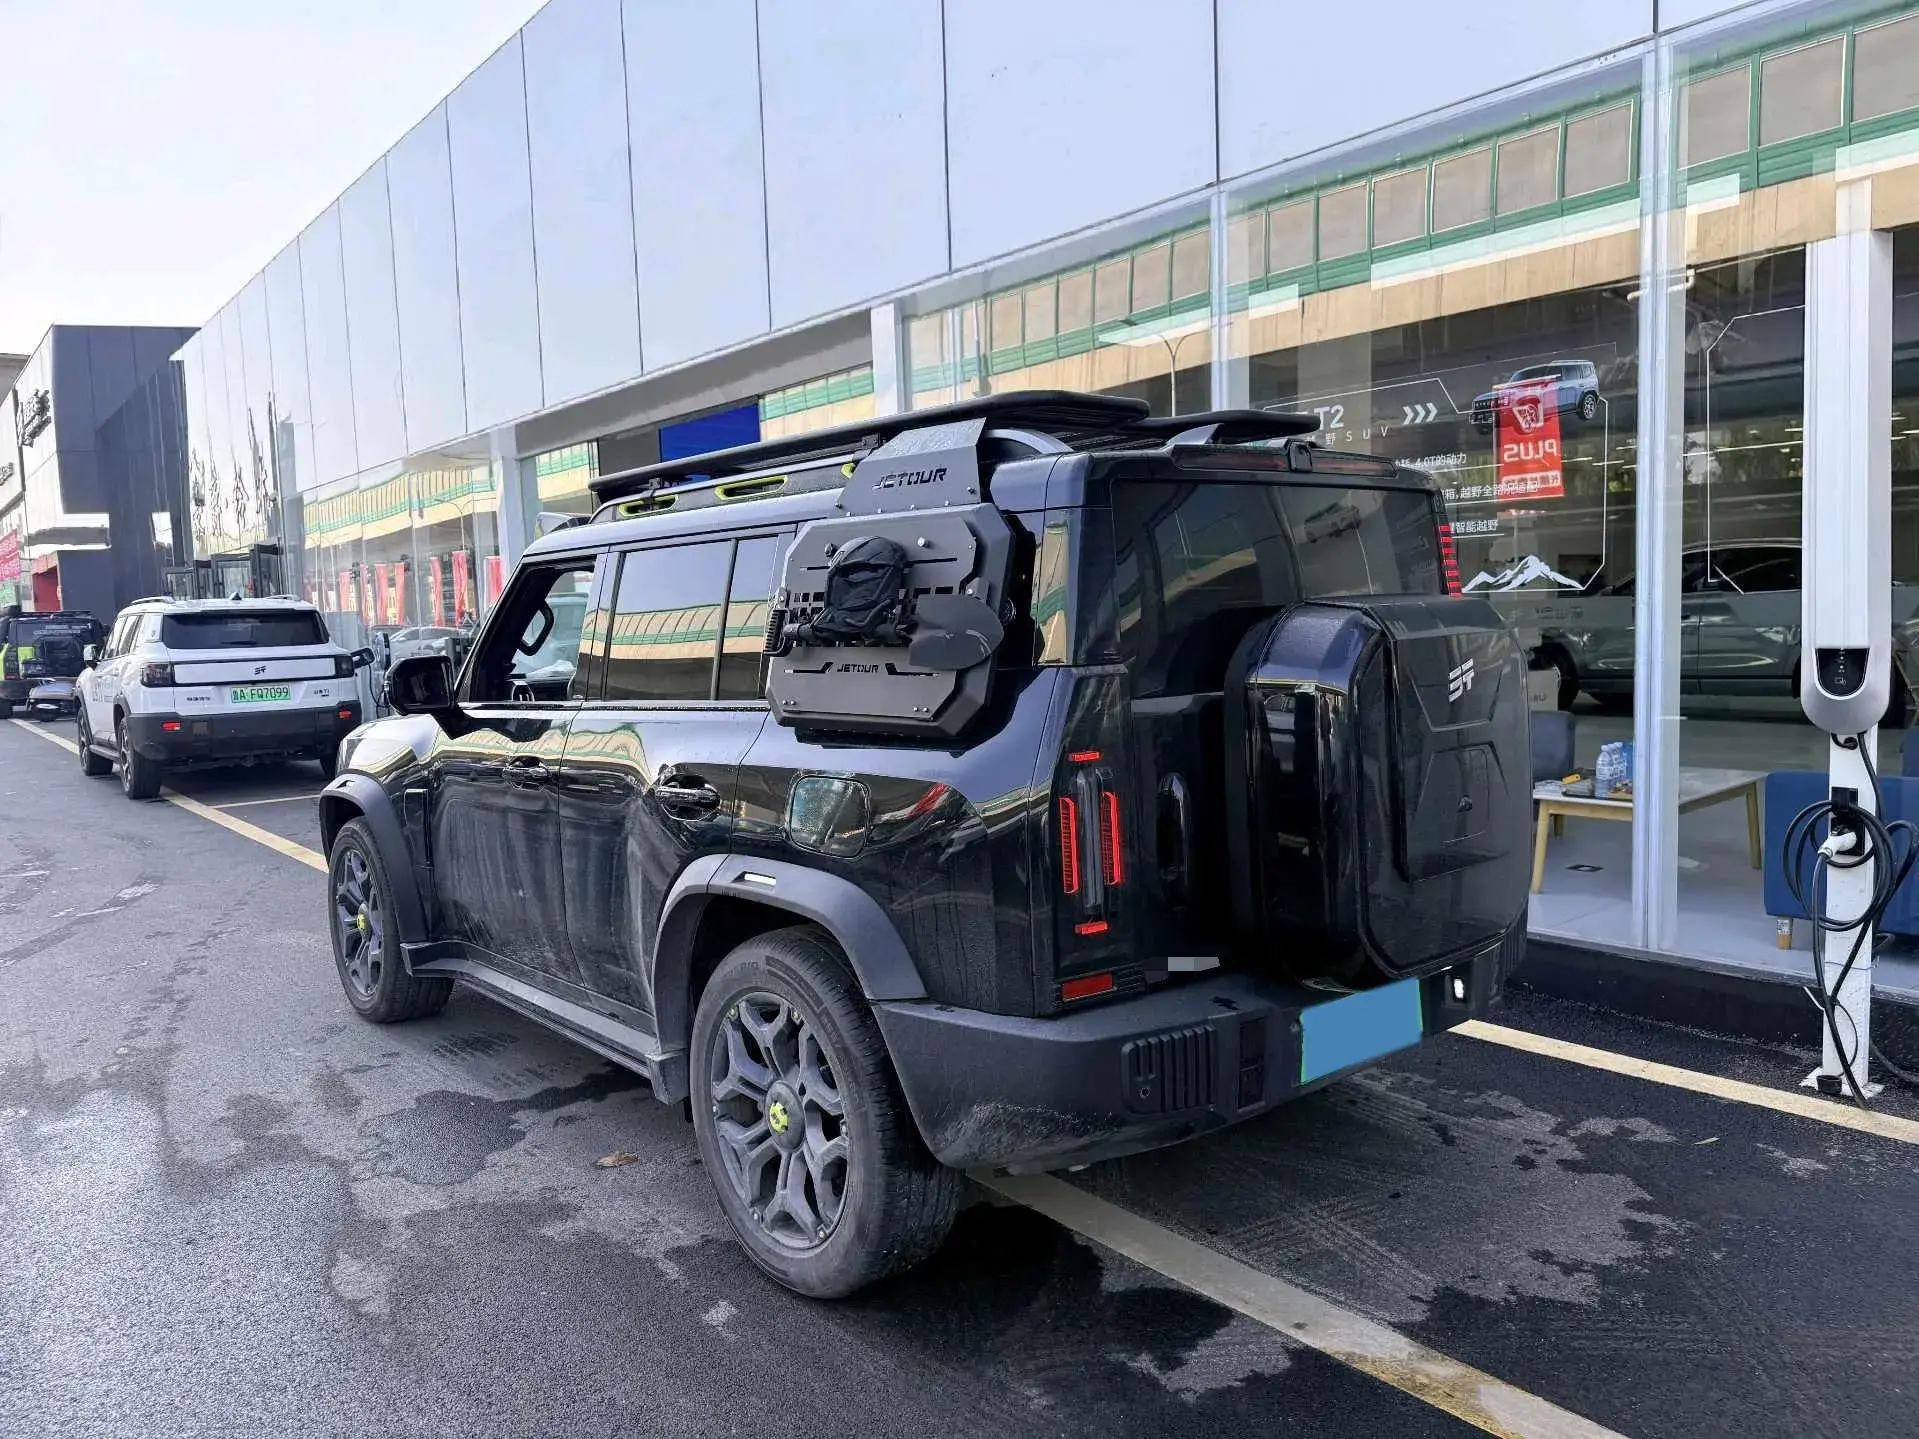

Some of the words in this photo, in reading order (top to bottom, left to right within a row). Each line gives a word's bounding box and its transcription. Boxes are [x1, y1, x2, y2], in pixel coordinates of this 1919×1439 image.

[1313, 405, 1345, 430] T2
[872, 468, 947, 490] JETOUR
[836, 663, 879, 674] JETOUR
